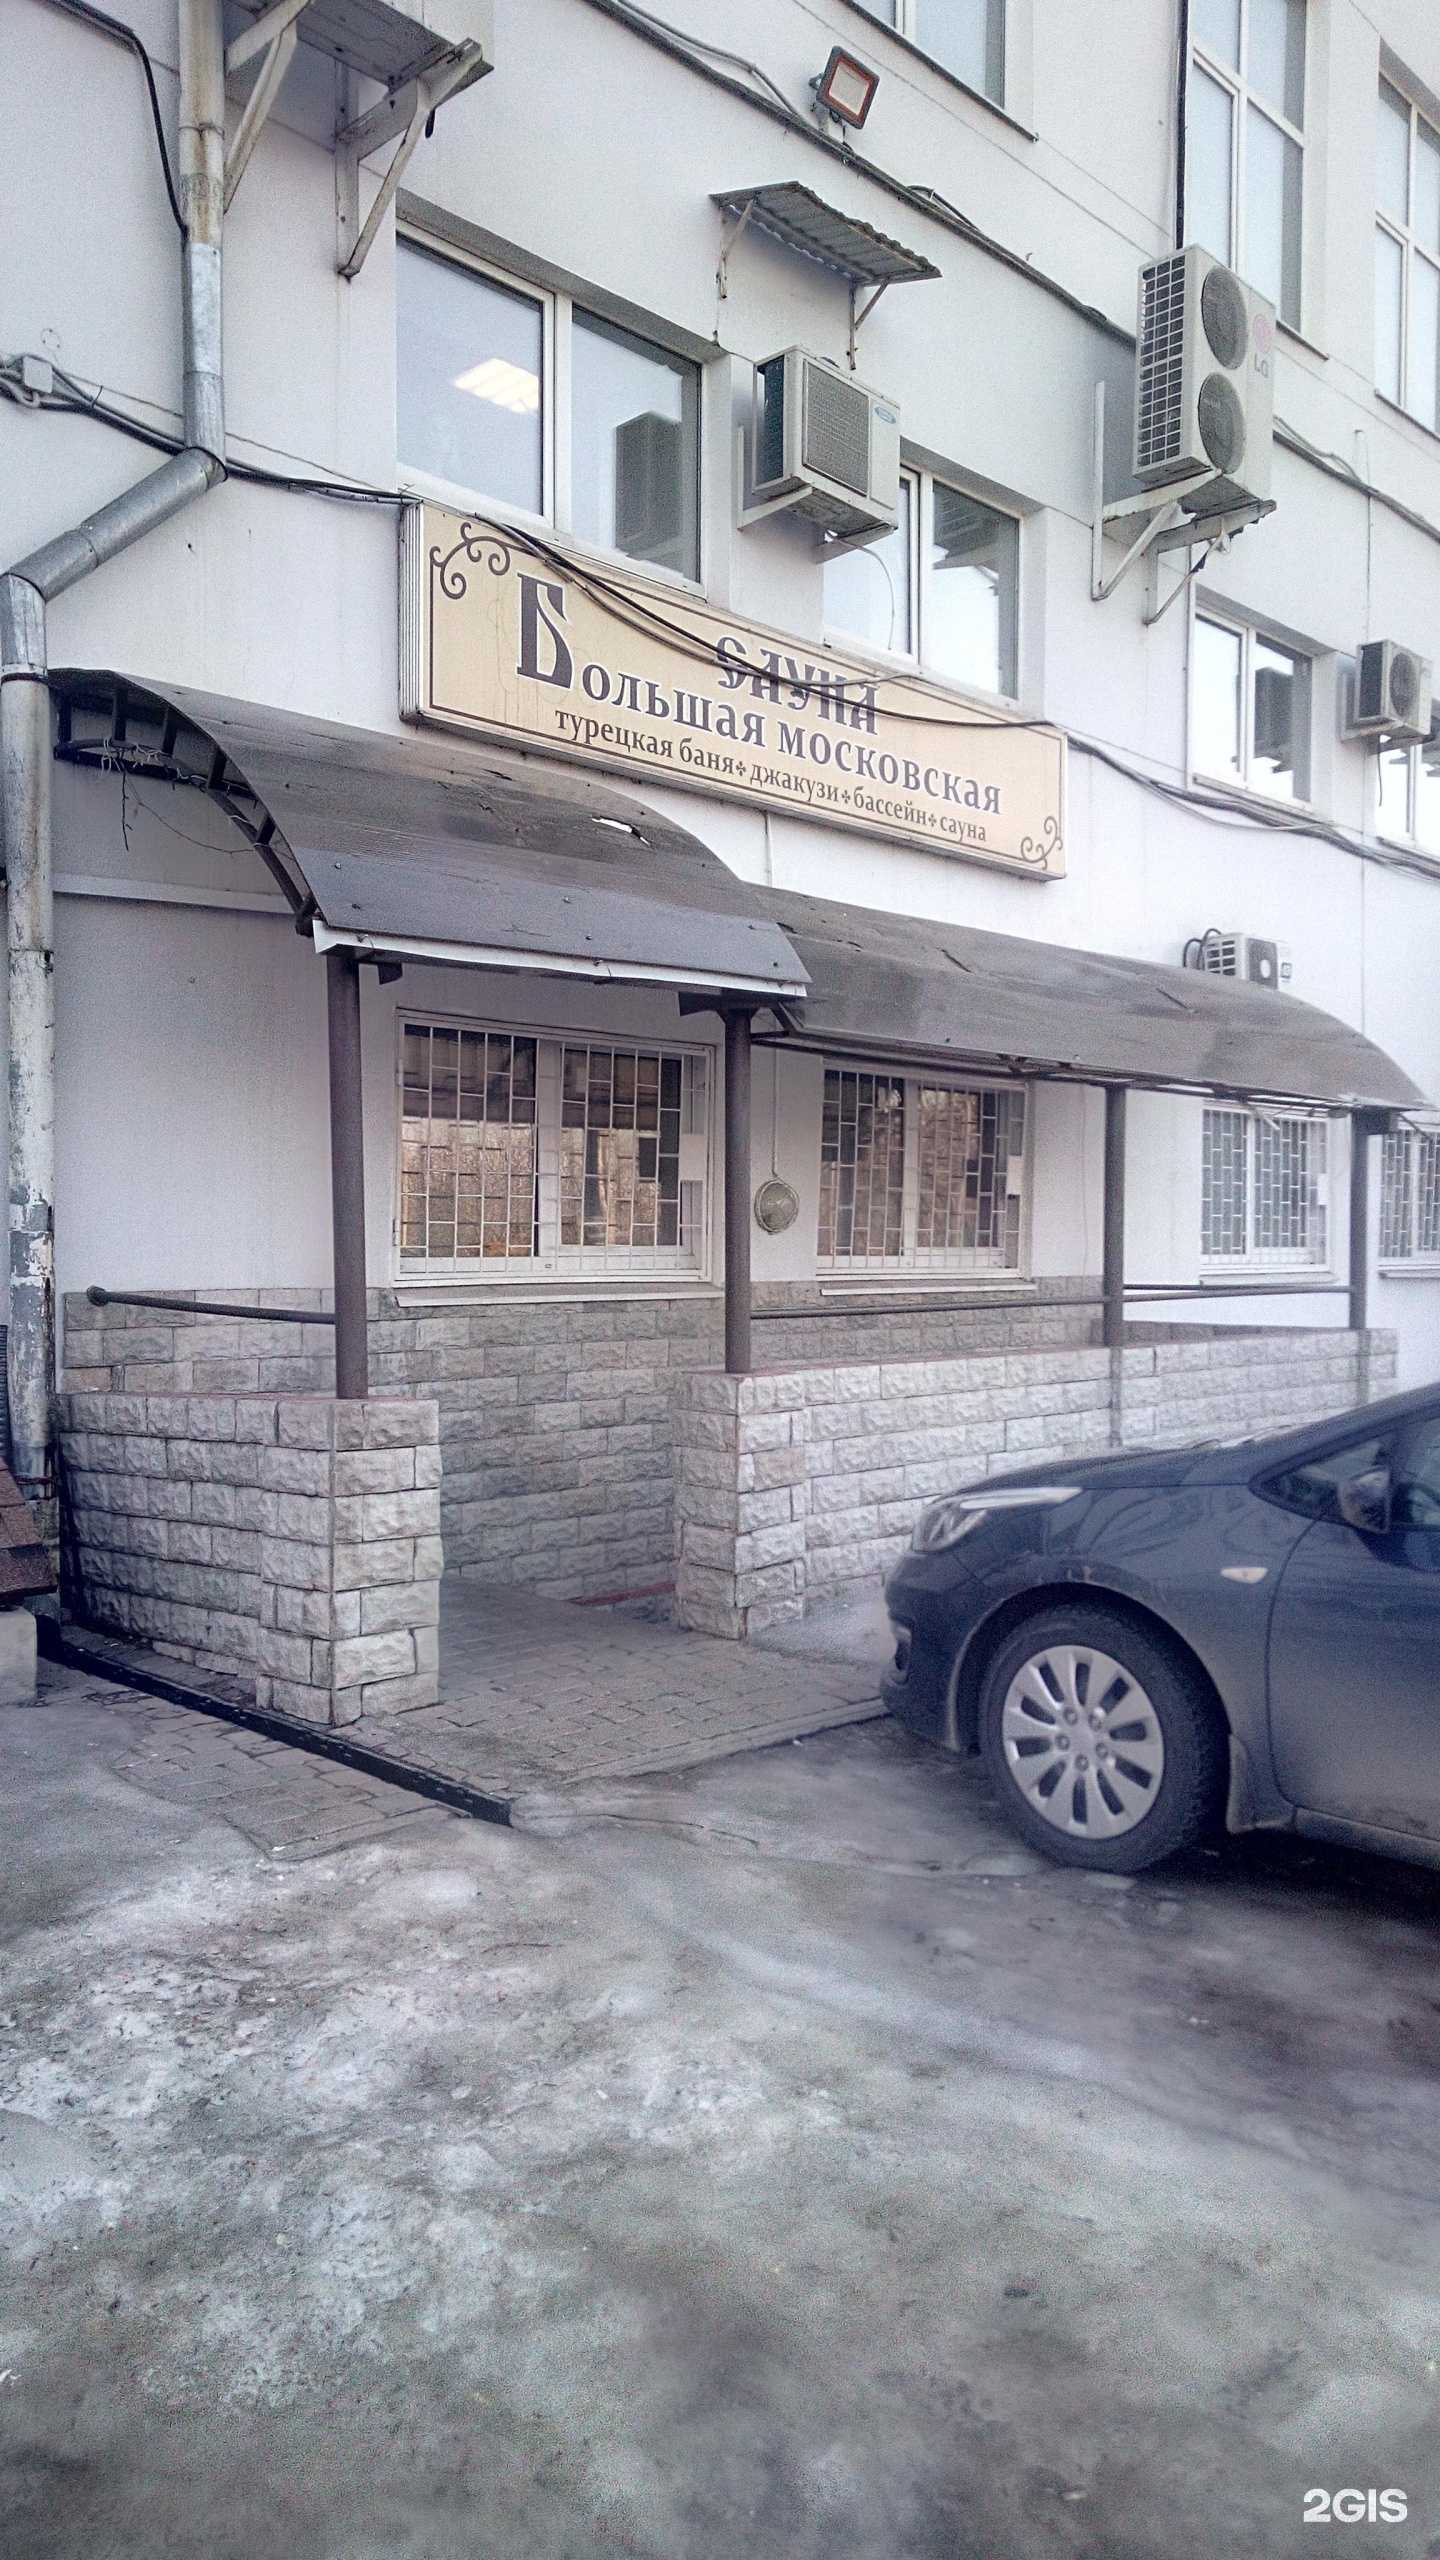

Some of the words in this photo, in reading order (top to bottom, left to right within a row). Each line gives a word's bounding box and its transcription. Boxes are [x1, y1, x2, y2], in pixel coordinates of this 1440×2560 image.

[516, 572, 766, 747] Большая
[777, 721, 1001, 814] московская
[715, 636, 878, 736] САУНА
[555, 710, 673, 758] турецкая
[679, 736, 735, 774] баня
[750, 763, 839, 801] джакузи
[853, 785, 928, 825] бассейн
[939, 814, 986, 842] сауна
